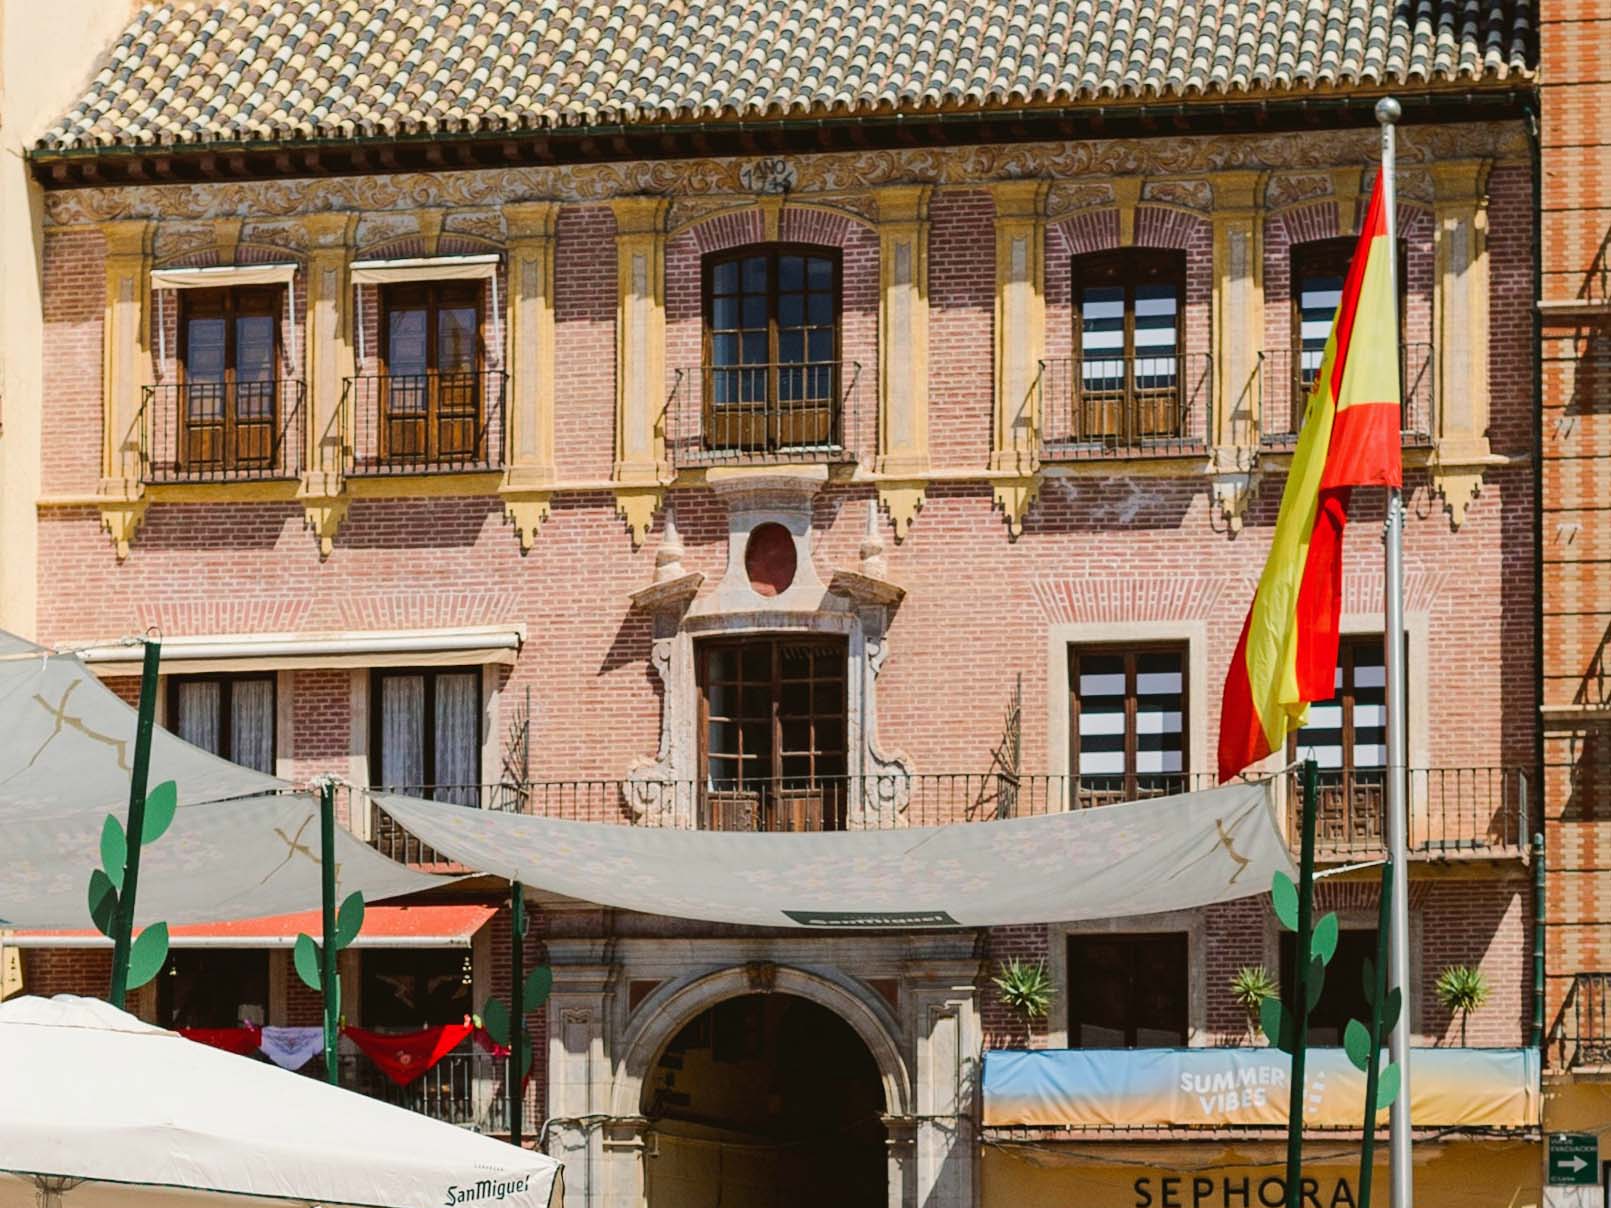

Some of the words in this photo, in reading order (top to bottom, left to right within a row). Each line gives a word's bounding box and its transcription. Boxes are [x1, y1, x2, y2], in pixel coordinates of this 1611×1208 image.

[1180, 1065, 1286, 1094] SUMMER
[1199, 1087, 1267, 1115] VIBES
[1134, 1176, 1356, 1208] SEPHORA
